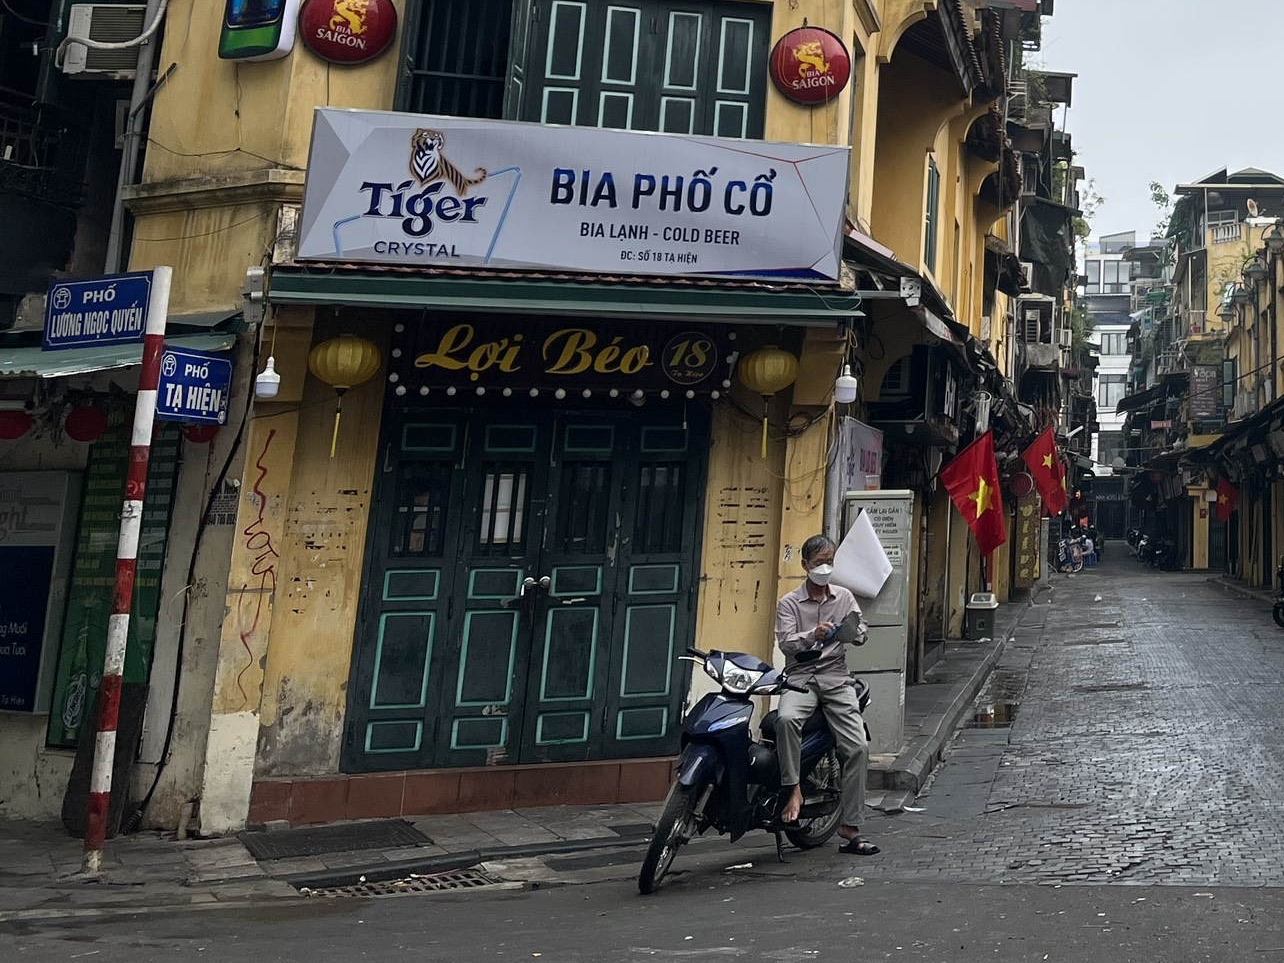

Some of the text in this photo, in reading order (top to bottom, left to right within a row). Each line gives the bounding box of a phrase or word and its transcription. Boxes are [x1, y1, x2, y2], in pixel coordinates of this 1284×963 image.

[315, 27, 367, 50] SAIGON
[335, 25, 352, 35] BIA
[792, 75, 836, 90] SAIGON
[806, 70, 821, 78] BIA
[550, 166, 778, 217] BIA PHỐ CỔ
[579, 222, 606, 238] BIA
[609, 223, 649, 242] LẠNH
[662, 226, 701, 243] COLD
[703, 228, 740, 245] BEER
[373, 240, 461, 257] CRYSTAL
[620, 249, 698, 266] ĐC: SỐ 18 TẠ HIỆN
[82, 283, 117, 304] PHỐ
[50, 300, 143, 339] LƯƠNG NGỌC QUYẾN
[542, 327, 654, 376] Béo
[668, 338, 713, 368] 18
[184, 361, 211, 380] PHỐ
[165, 382, 222, 416] TẠ HIỆN
